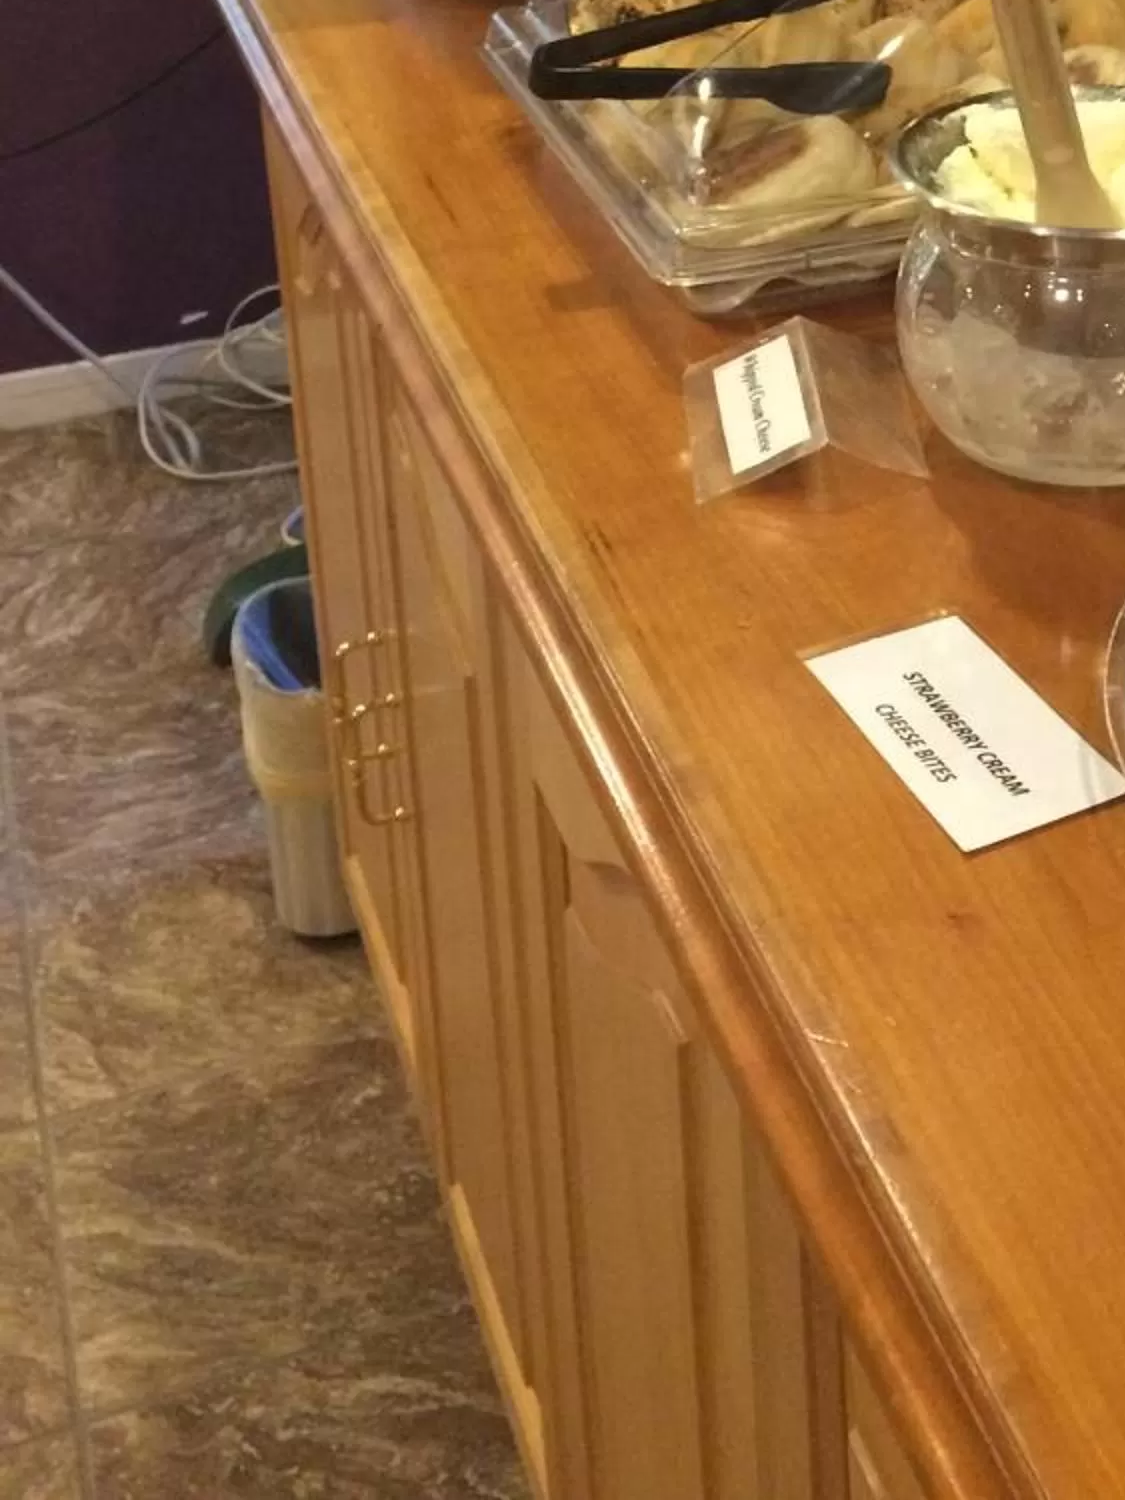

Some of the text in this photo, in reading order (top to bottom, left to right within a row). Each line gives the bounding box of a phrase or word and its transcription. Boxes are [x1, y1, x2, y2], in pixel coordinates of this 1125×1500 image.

[875, 703, 957, 785] CHEESE BITES
[903, 671, 1032, 797] STRAWBERRY CREAM
